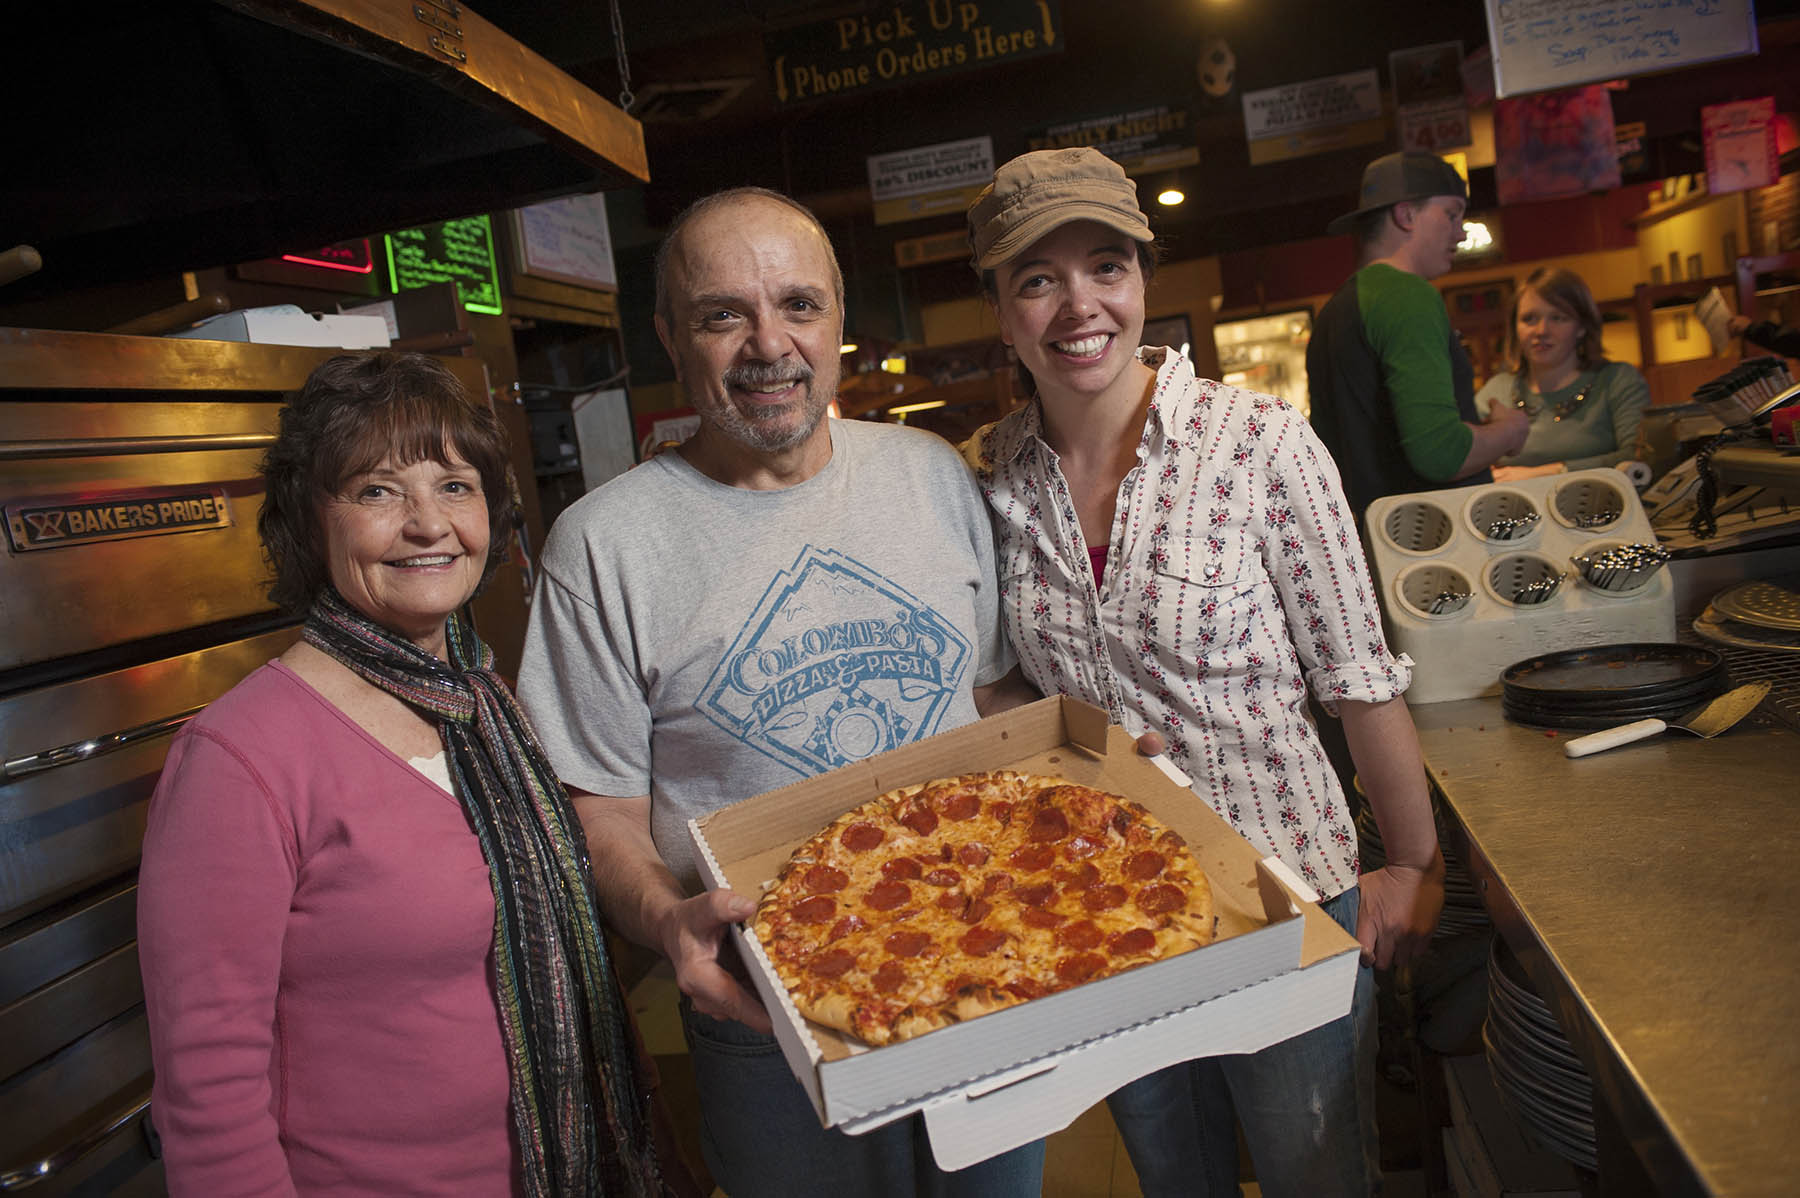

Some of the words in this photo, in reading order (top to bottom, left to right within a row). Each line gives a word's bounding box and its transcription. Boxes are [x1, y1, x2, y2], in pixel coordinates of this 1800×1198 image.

[839, 7, 916, 50] Pick
[928, 0, 978, 32] Up
[793, 64, 870, 96] Phone
[876, 43, 967, 78] Orders
[973, 26, 1036, 59] Here
[1115, 112, 1186, 140] NIGHT
[907, 159, 989, 183] DISCOUNT
[67, 503, 158, 534] BAKERS
[158, 498, 215, 524] PRIDE
[730, 609, 946, 695] COLOMBO'S
[760, 670, 823, 718] PIZZA
[834, 653, 865, 688] &
[866, 654, 936, 679] PASTA
